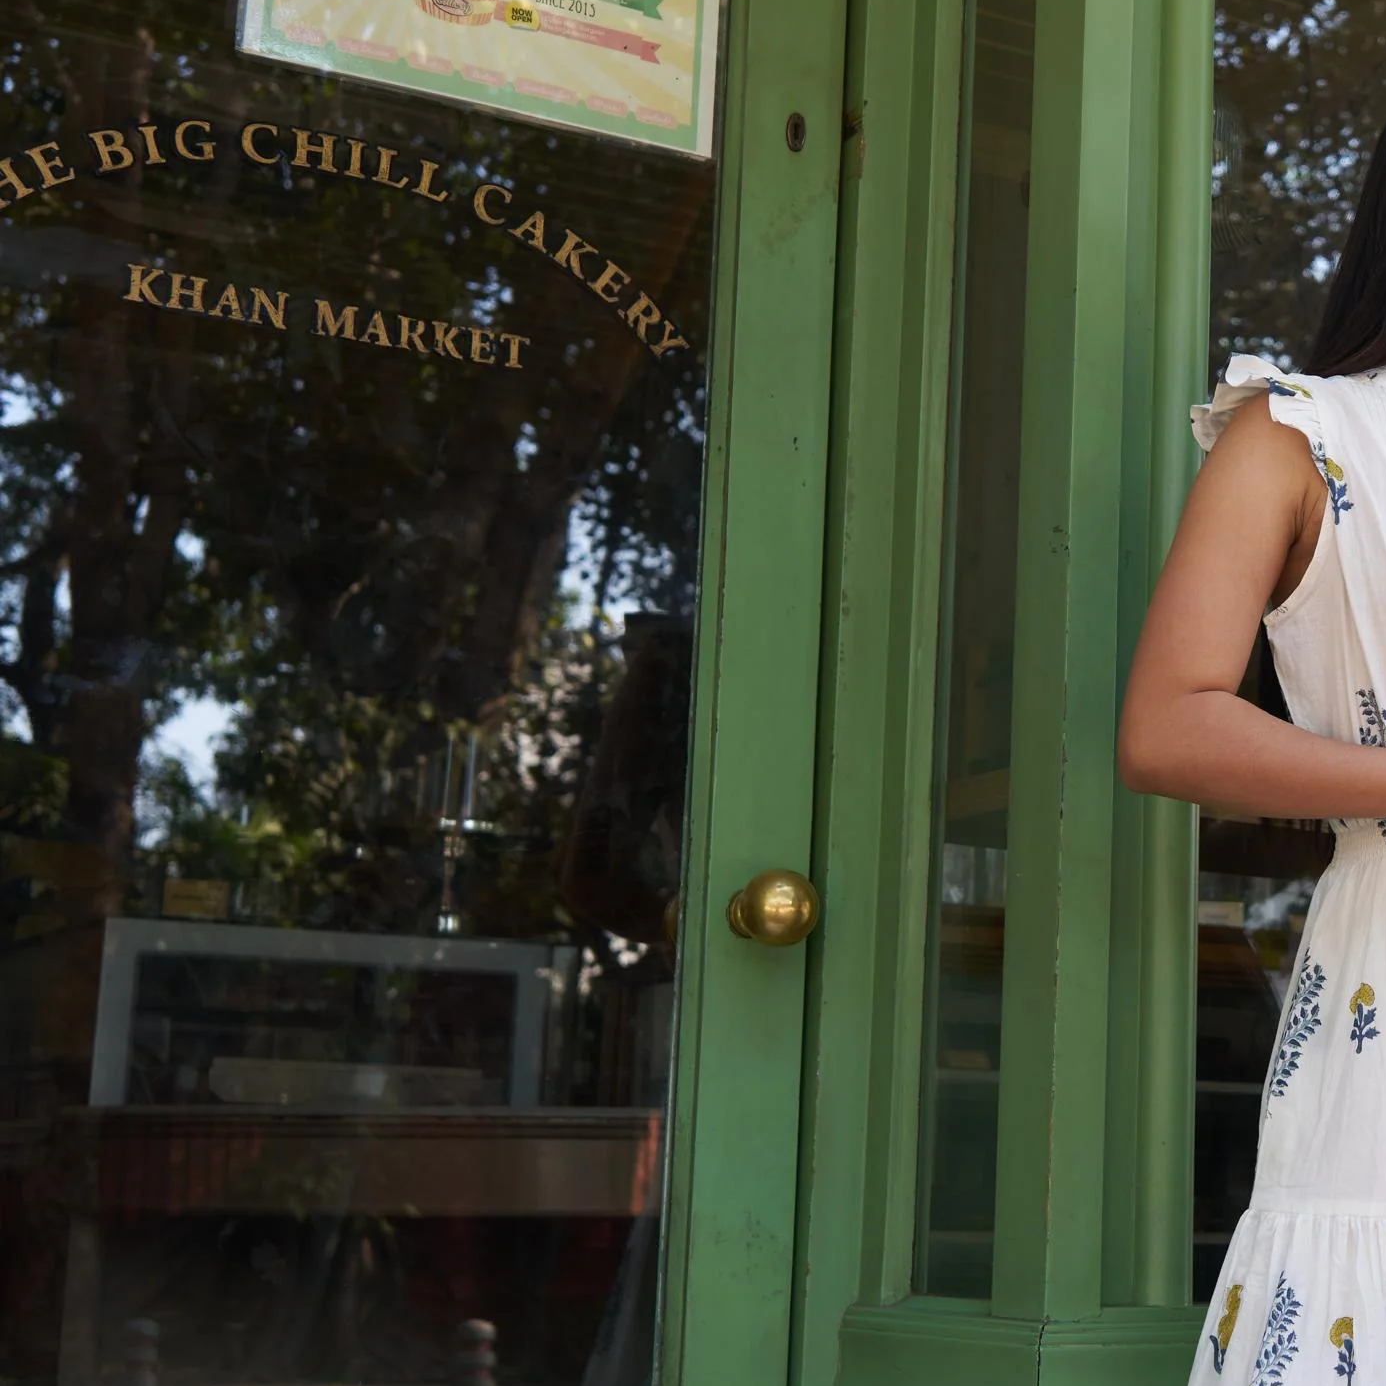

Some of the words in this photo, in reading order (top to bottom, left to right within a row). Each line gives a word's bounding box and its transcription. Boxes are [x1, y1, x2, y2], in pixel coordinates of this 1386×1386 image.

[510, 14, 533, 24] OPEN
[511, 7, 533, 17] NOW
[0, 141, 75, 209] HE
[88, 120, 217, 172] BIG
[240, 123, 449, 203] CHILL
[472, 183, 691, 359] CAKERY
[126, 263, 290, 330] KHAN
[312, 298, 531, 369] MARKET
